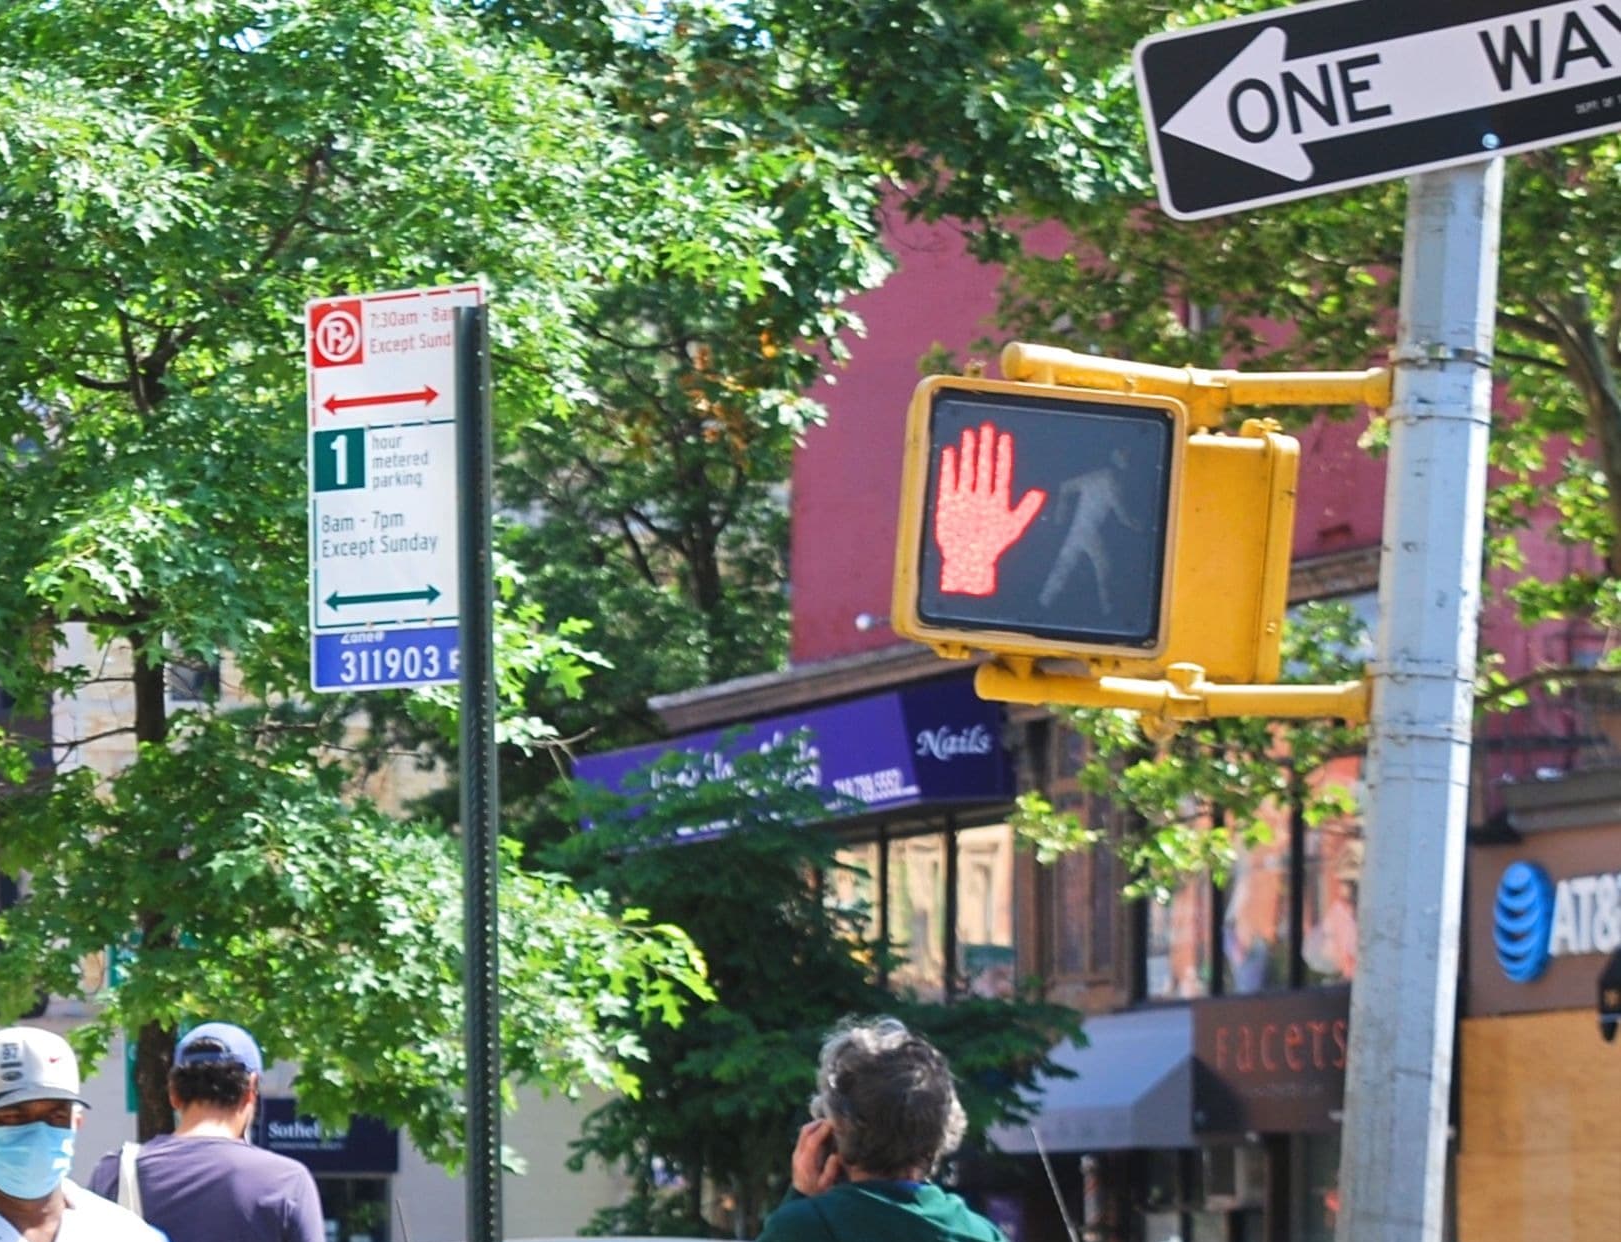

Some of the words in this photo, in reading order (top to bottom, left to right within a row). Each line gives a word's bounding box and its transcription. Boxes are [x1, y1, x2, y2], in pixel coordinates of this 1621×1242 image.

[1227, 53, 1392, 144] ONE
[370, 336, 415, 354] Except
[419, 332, 451, 348] Sund
[372, 435, 402, 449] hour
[330, 434, 348, 486] 1
[372, 452, 429, 469] metered
[372, 472, 423, 489] parking
[321, 514, 354, 533] 8am
[371, 511, 404, 530] 7pm
[322, 537, 375, 558] Except
[380, 533, 438, 554] Sunday
[340, 645, 441, 683] 311903
[916, 724, 992, 760] Nails
[1548, 873, 1621, 957] AT&
